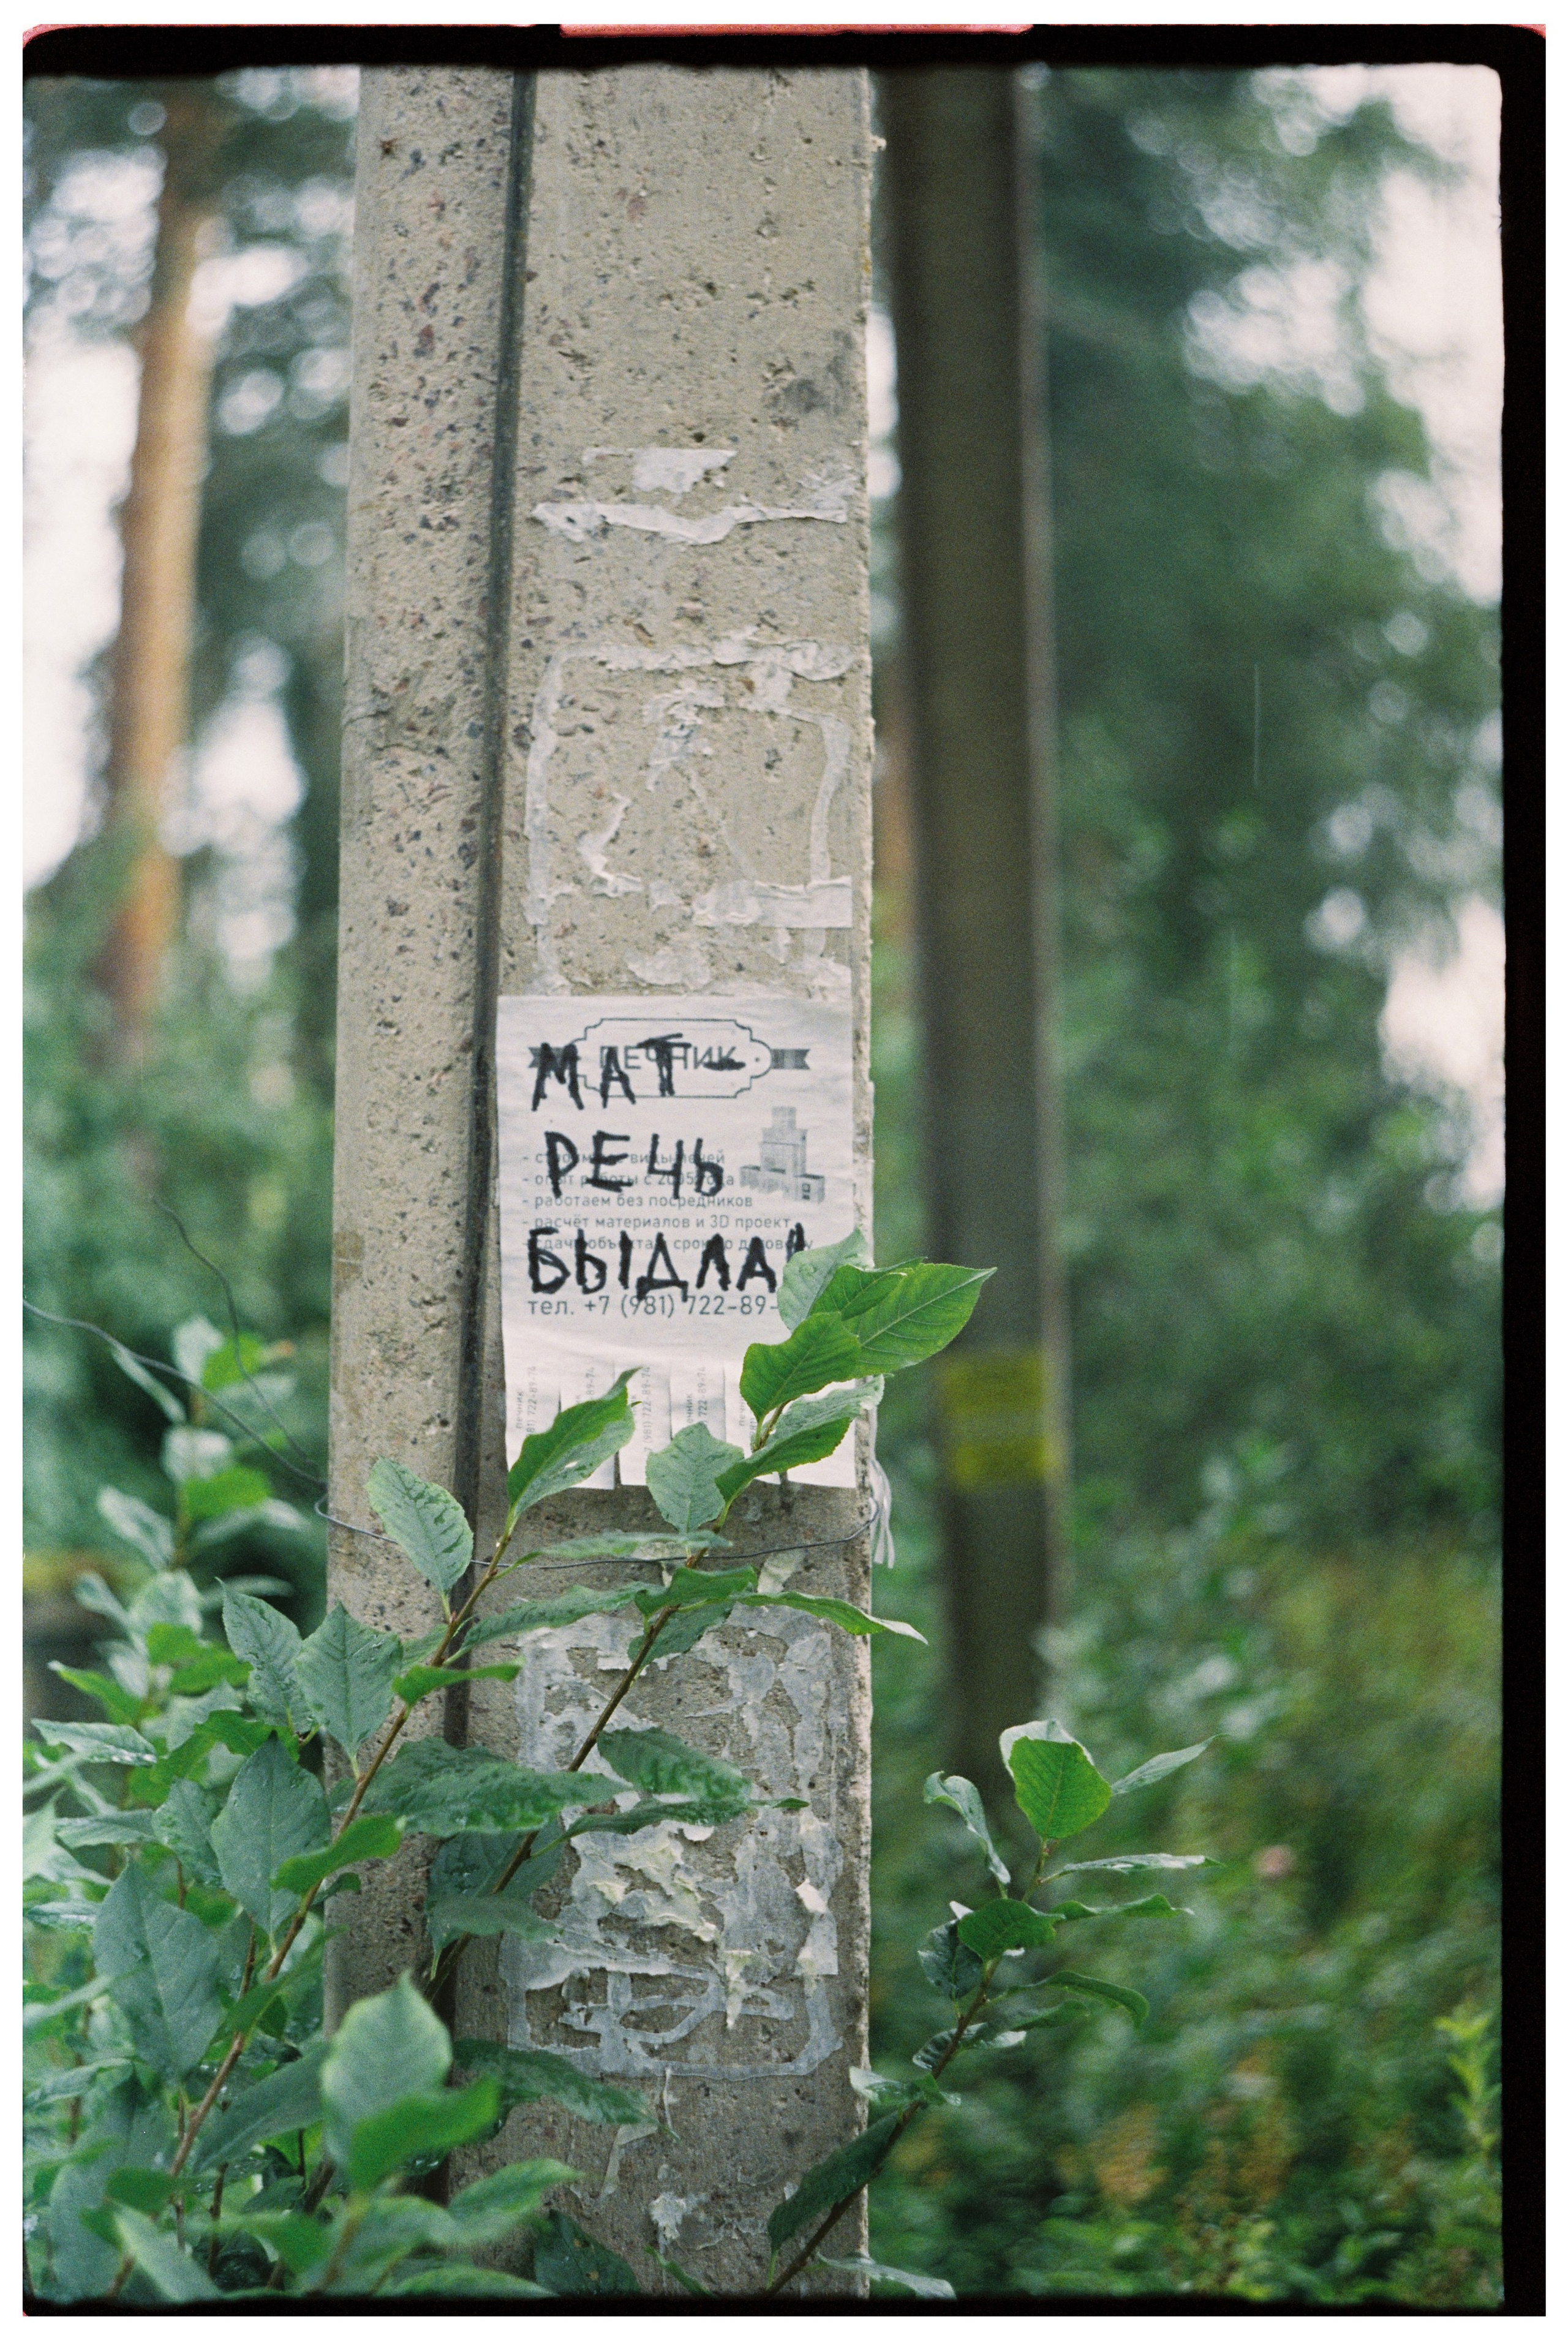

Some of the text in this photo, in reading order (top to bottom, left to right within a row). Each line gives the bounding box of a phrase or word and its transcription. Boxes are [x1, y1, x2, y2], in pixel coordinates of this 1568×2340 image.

[531, 1032, 692, 1111] МАТ
[545, 1130, 724, 1199] РЕЧЬ
[535, 1194, 611, 1209] работаем
[617, 1194, 643, 1206] без
[649, 1196, 753, 1210] посредников
[535, 1213, 589, 1229] расчёт
[595, 1218, 690, 1231] материалов
[696, 1218, 704, 1228] и
[710, 1214, 729, 1228] 3D
[736, 1218, 791, 1232] проект
[528, 1294, 778, 1318] тел. +7 (981) 722-89-
